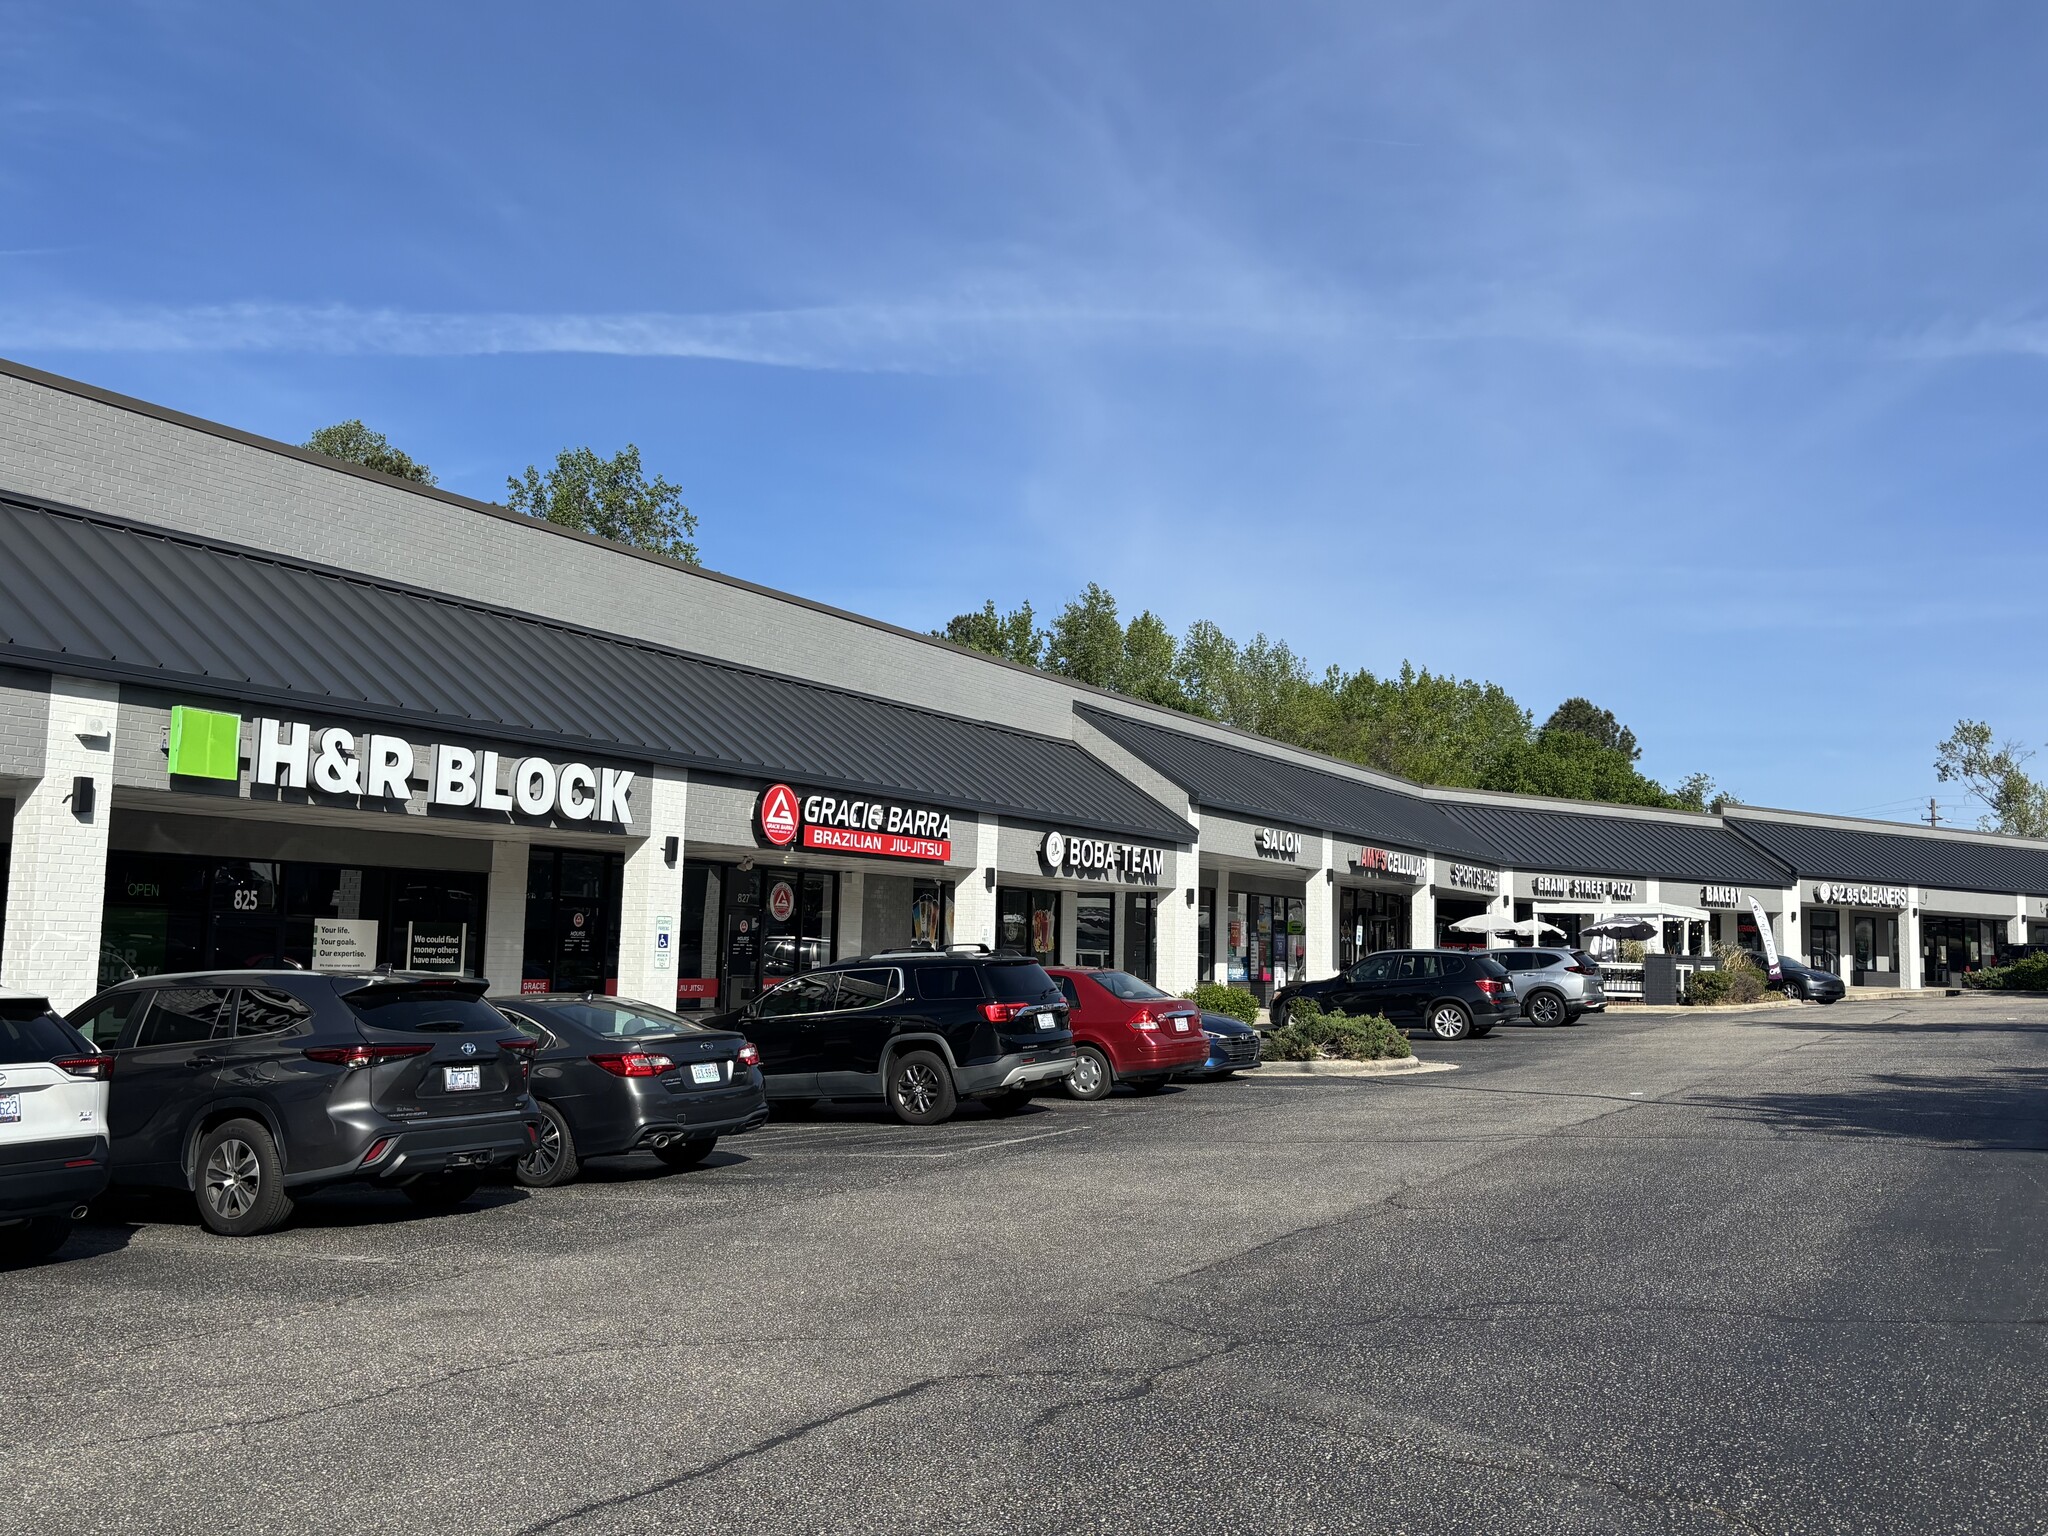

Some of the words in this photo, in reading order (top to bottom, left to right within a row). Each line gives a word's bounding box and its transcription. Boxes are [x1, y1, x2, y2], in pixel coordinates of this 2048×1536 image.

[252, 717, 413, 800] H&R
[431, 743, 635, 825] BLOCK
[804, 795, 882, 830] GRACIE
[887, 806, 951, 839] BARRA
[813, 829, 882, 850] BRAZILIAN
[890, 840, 943, 857] JIU-JITSU
[1262, 828, 1301, 854] SALON
[1069, 838, 1115, 870] BOBA
[1121, 845, 1164, 875] TEAM
[1361, 847, 1387, 871] AMY'S
[1387, 854, 1427, 878] CELLULAR
[1454, 864, 1481, 885] SPORTS
[1482, 870, 1498, 888] PAGE
[127, 883, 160, 897] OPEN
[1537, 876, 1569, 892] GRAND
[1574, 880, 1607, 894] STREET
[1611, 881, 1637, 896] PIZZA
[1706, 886, 1742, 903] BAKERY
[233, 889, 258, 910] 825
[737, 893, 750, 903] 827
[1860, 885, 1907, 906] CLEANERS
[321, 926, 336, 934] Your
[337, 926, 350, 934] life.
[320, 938, 336, 946] Your
[336, 938, 356, 947] goals.
[414, 935, 425, 943] We
[426, 935, 445, 943] could
[445, 936, 459, 944] find
[333, 950, 366, 958] expertise.
[413, 947, 436, 955] money
[437, 946, 459, 954] others
[413, 956, 429, 964] have
[430, 956, 455, 964] missed.
[523, 982, 547, 990] GRACIE
